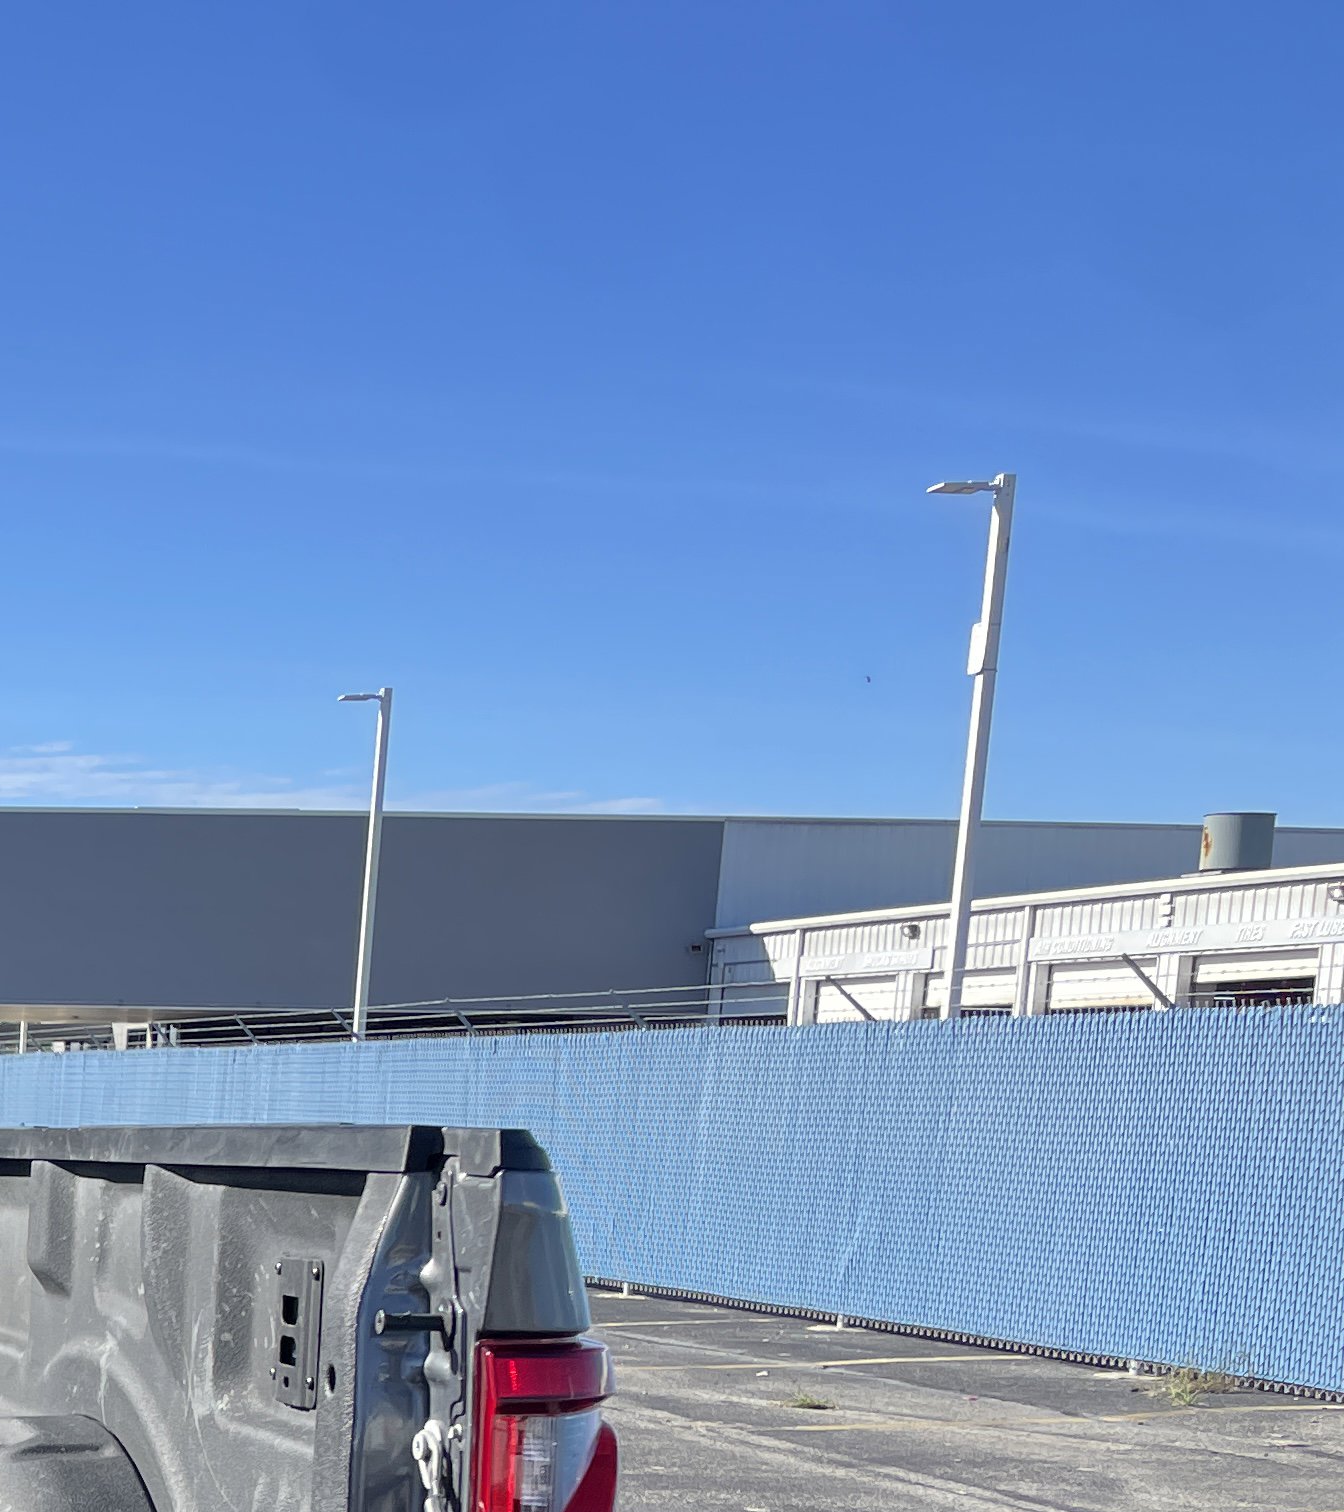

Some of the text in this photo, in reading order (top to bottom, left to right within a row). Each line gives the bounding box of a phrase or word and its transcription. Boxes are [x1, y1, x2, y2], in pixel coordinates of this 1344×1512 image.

[1147, 929, 1204, 949] ALIGNMENT
[1235, 924, 1267, 943] TIRES
[1288, 919, 1319, 940] FAST
